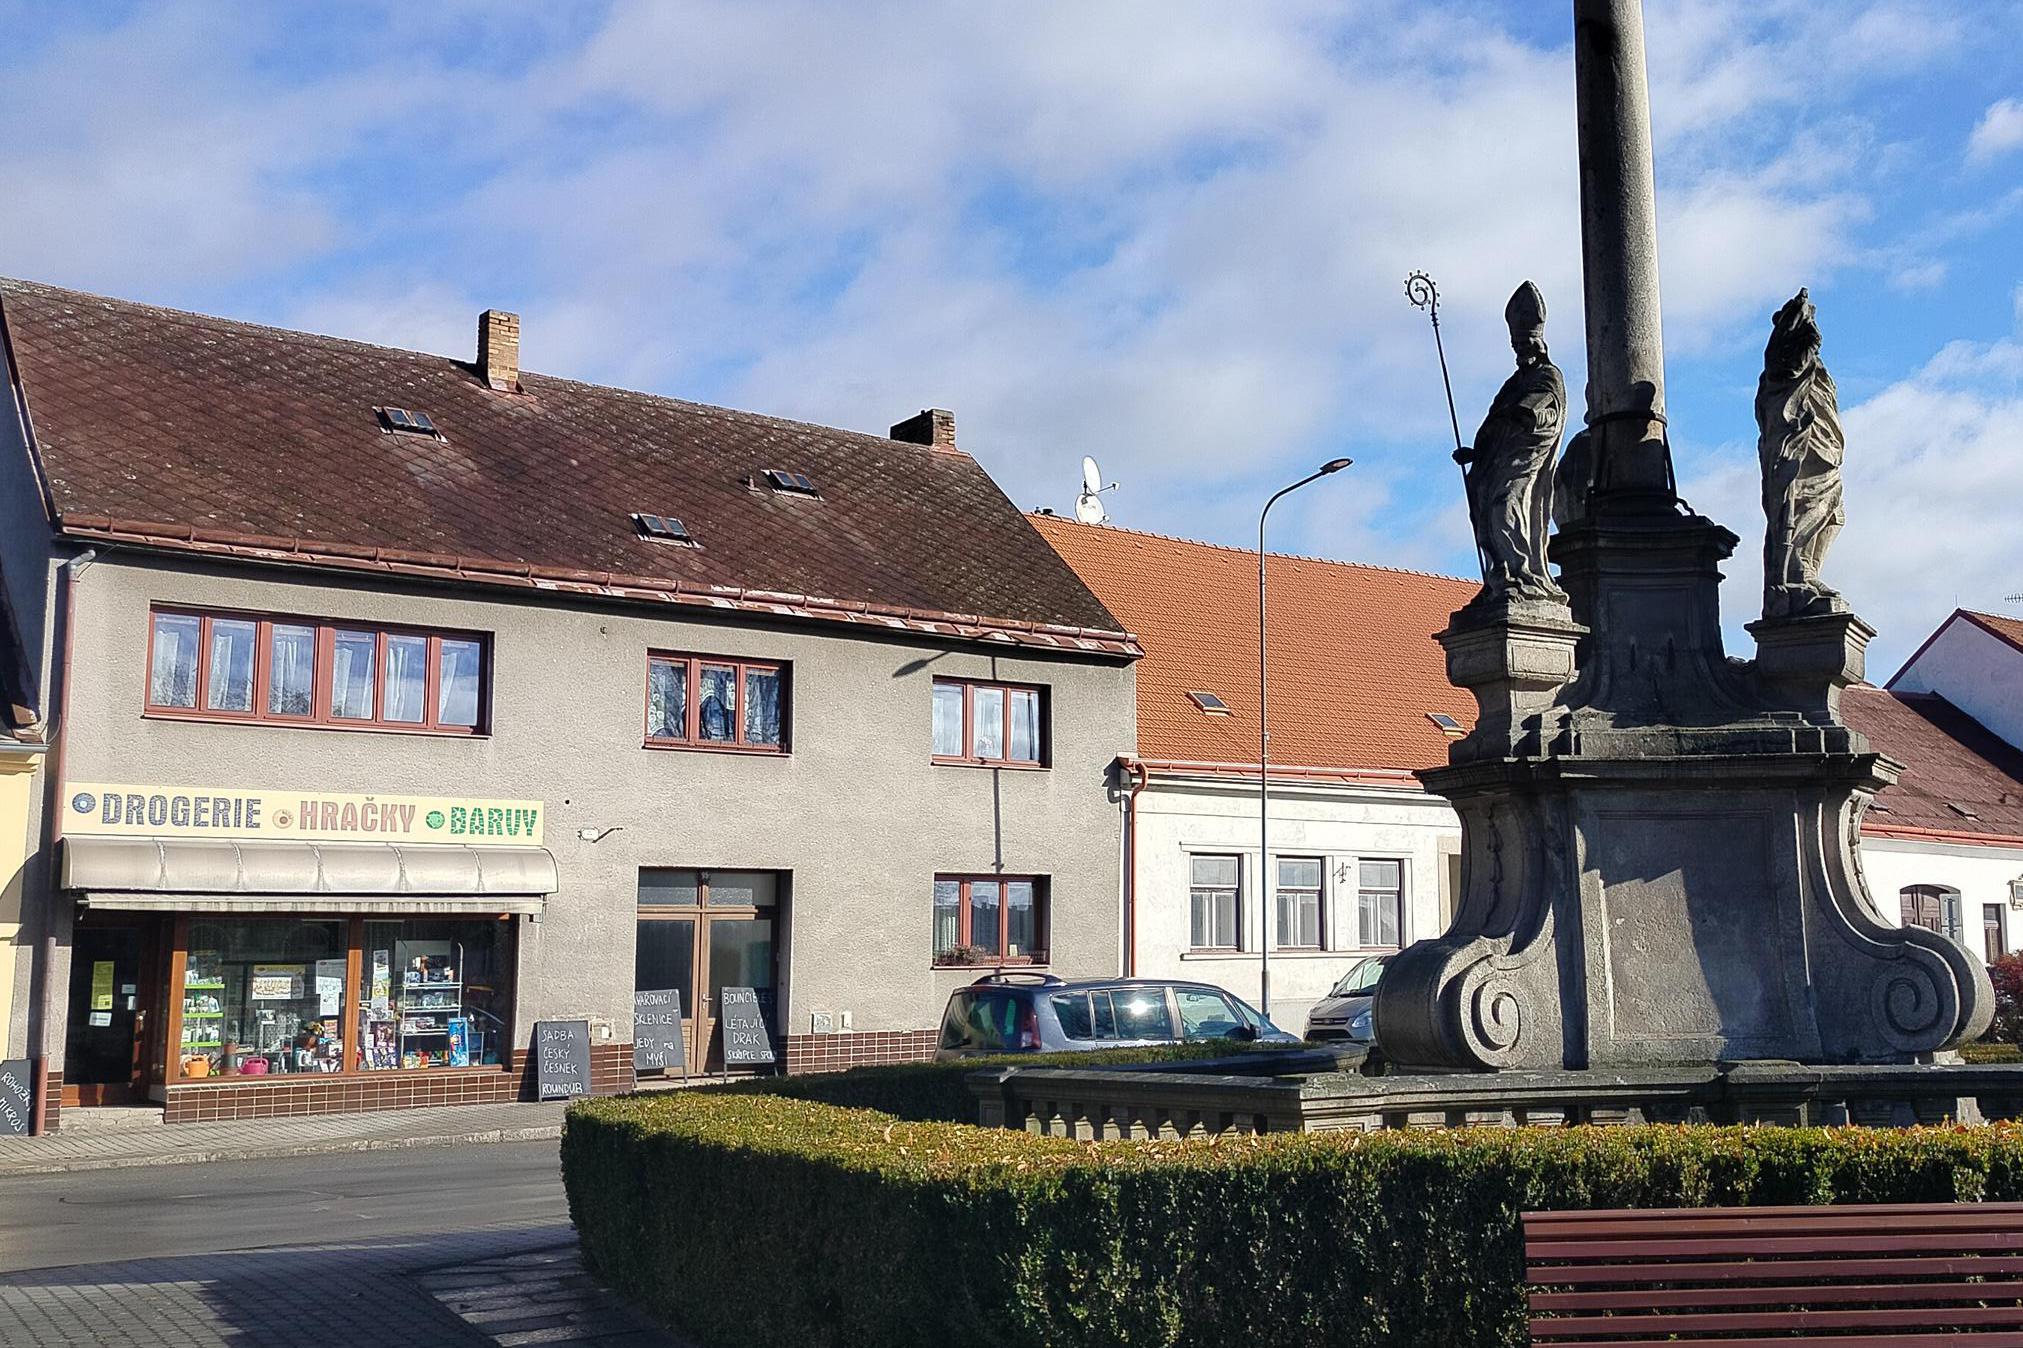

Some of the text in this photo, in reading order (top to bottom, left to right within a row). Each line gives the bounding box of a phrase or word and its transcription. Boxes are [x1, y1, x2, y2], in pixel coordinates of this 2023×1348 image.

[102, 793, 537, 836] DROGERIE HRAČKY BARVY
[634, 1013, 672, 1025] SKLENICE
[542, 1029, 574, 1042] SADBA
[733, 1032, 760, 1046] DRAK
[634, 1037, 654, 1049] JEDY
[543, 1043, 570, 1060] ČESKÝ
[543, 1060, 578, 1074] ČESNEK
